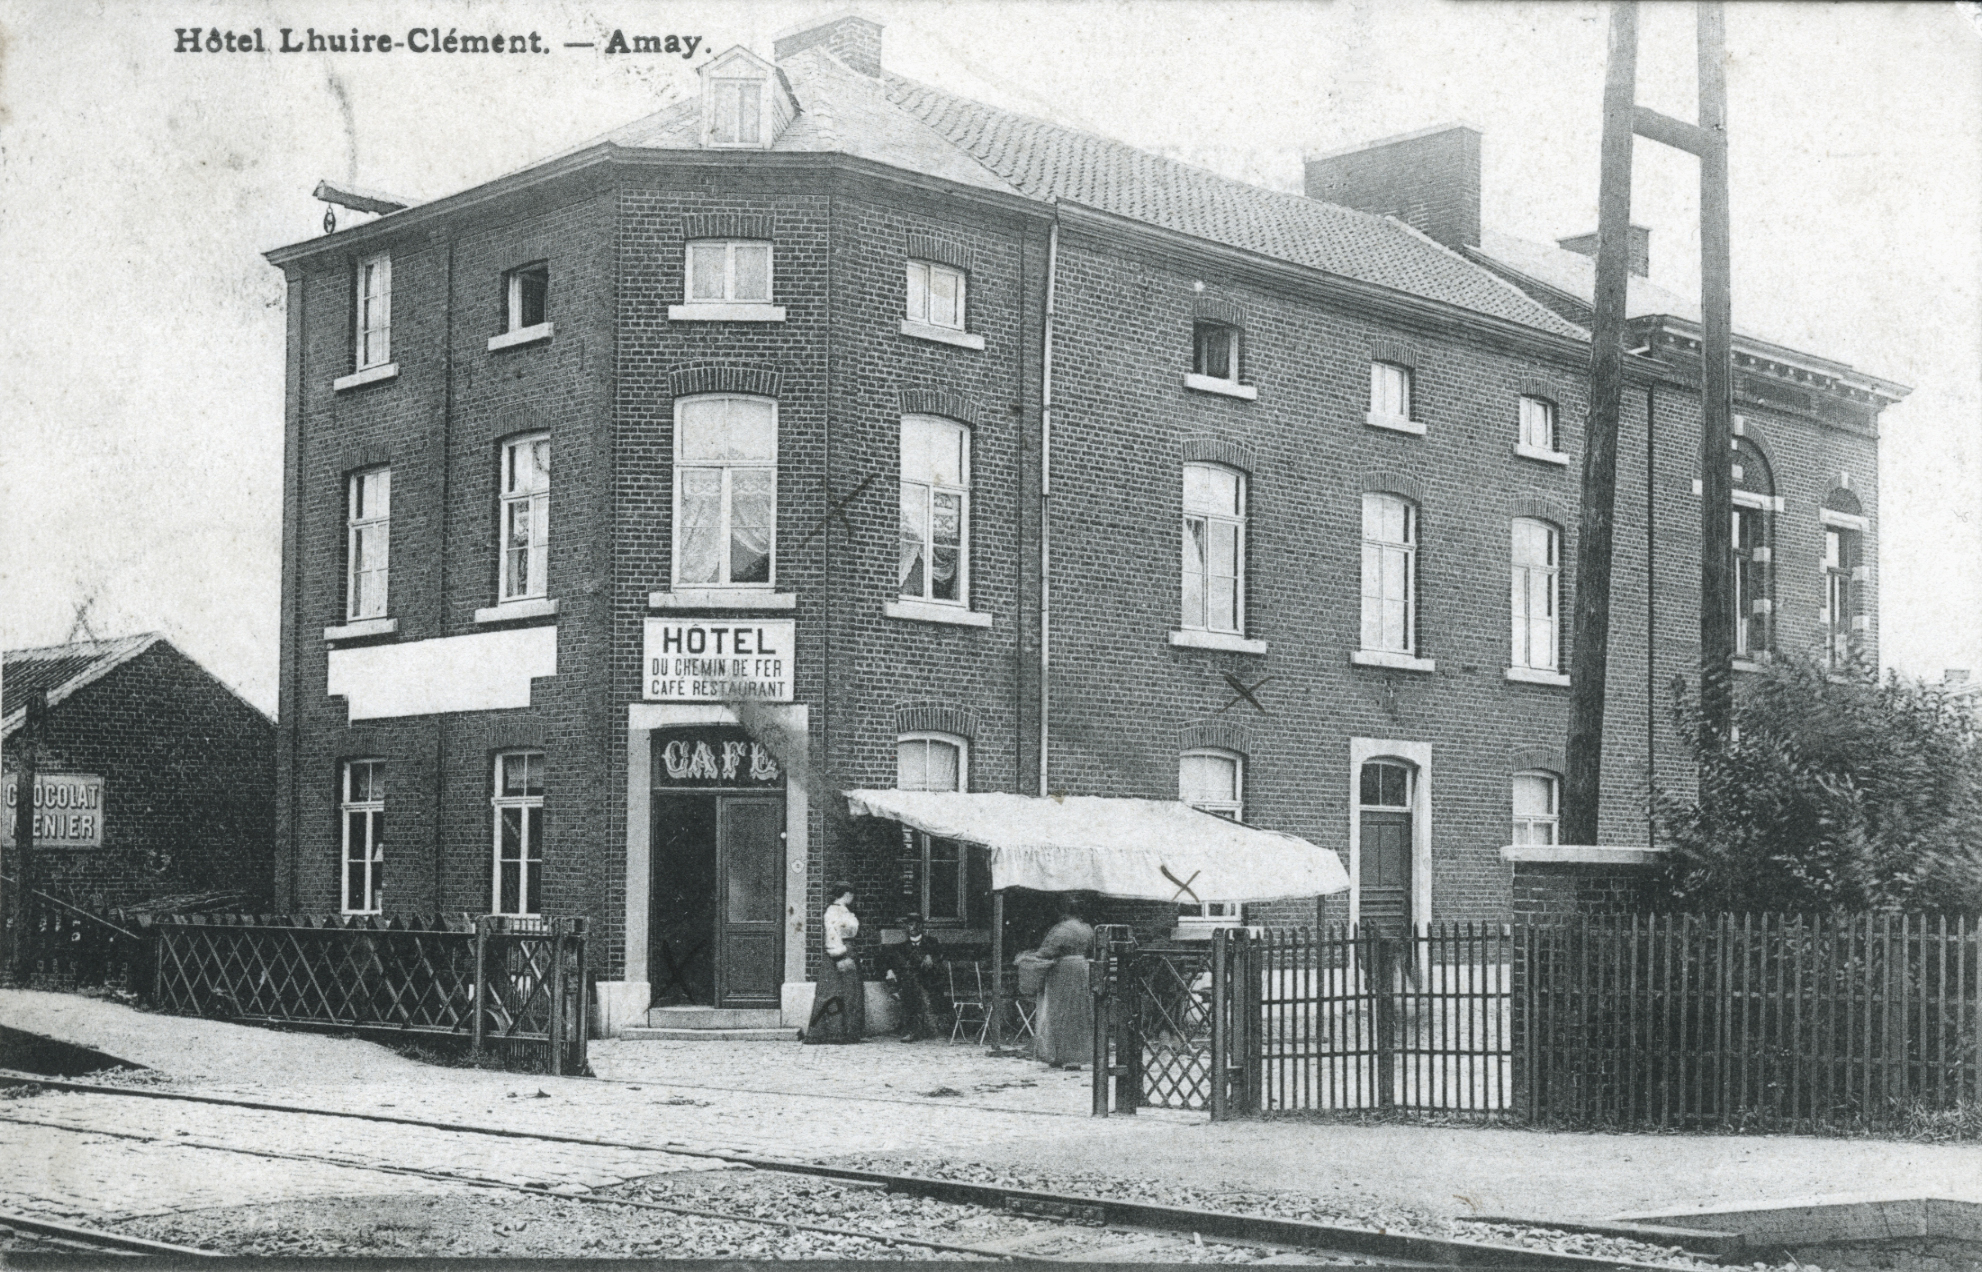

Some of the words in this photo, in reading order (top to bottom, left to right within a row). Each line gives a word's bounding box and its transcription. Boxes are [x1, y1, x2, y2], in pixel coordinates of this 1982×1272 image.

[663, 623, 776, 655] HÔTEL
[652, 658, 668, 676] DU
[675, 658, 726, 676] CHEMIN
[733, 659, 749, 677] DE
[755, 659, 782, 678] FER
[651, 676, 686, 696] CAFÉ
[692, 680, 786, 698] RESTAURANT
[6, 783, 98, 810] COCOLAT
[10, 814, 95, 839] ENIER
